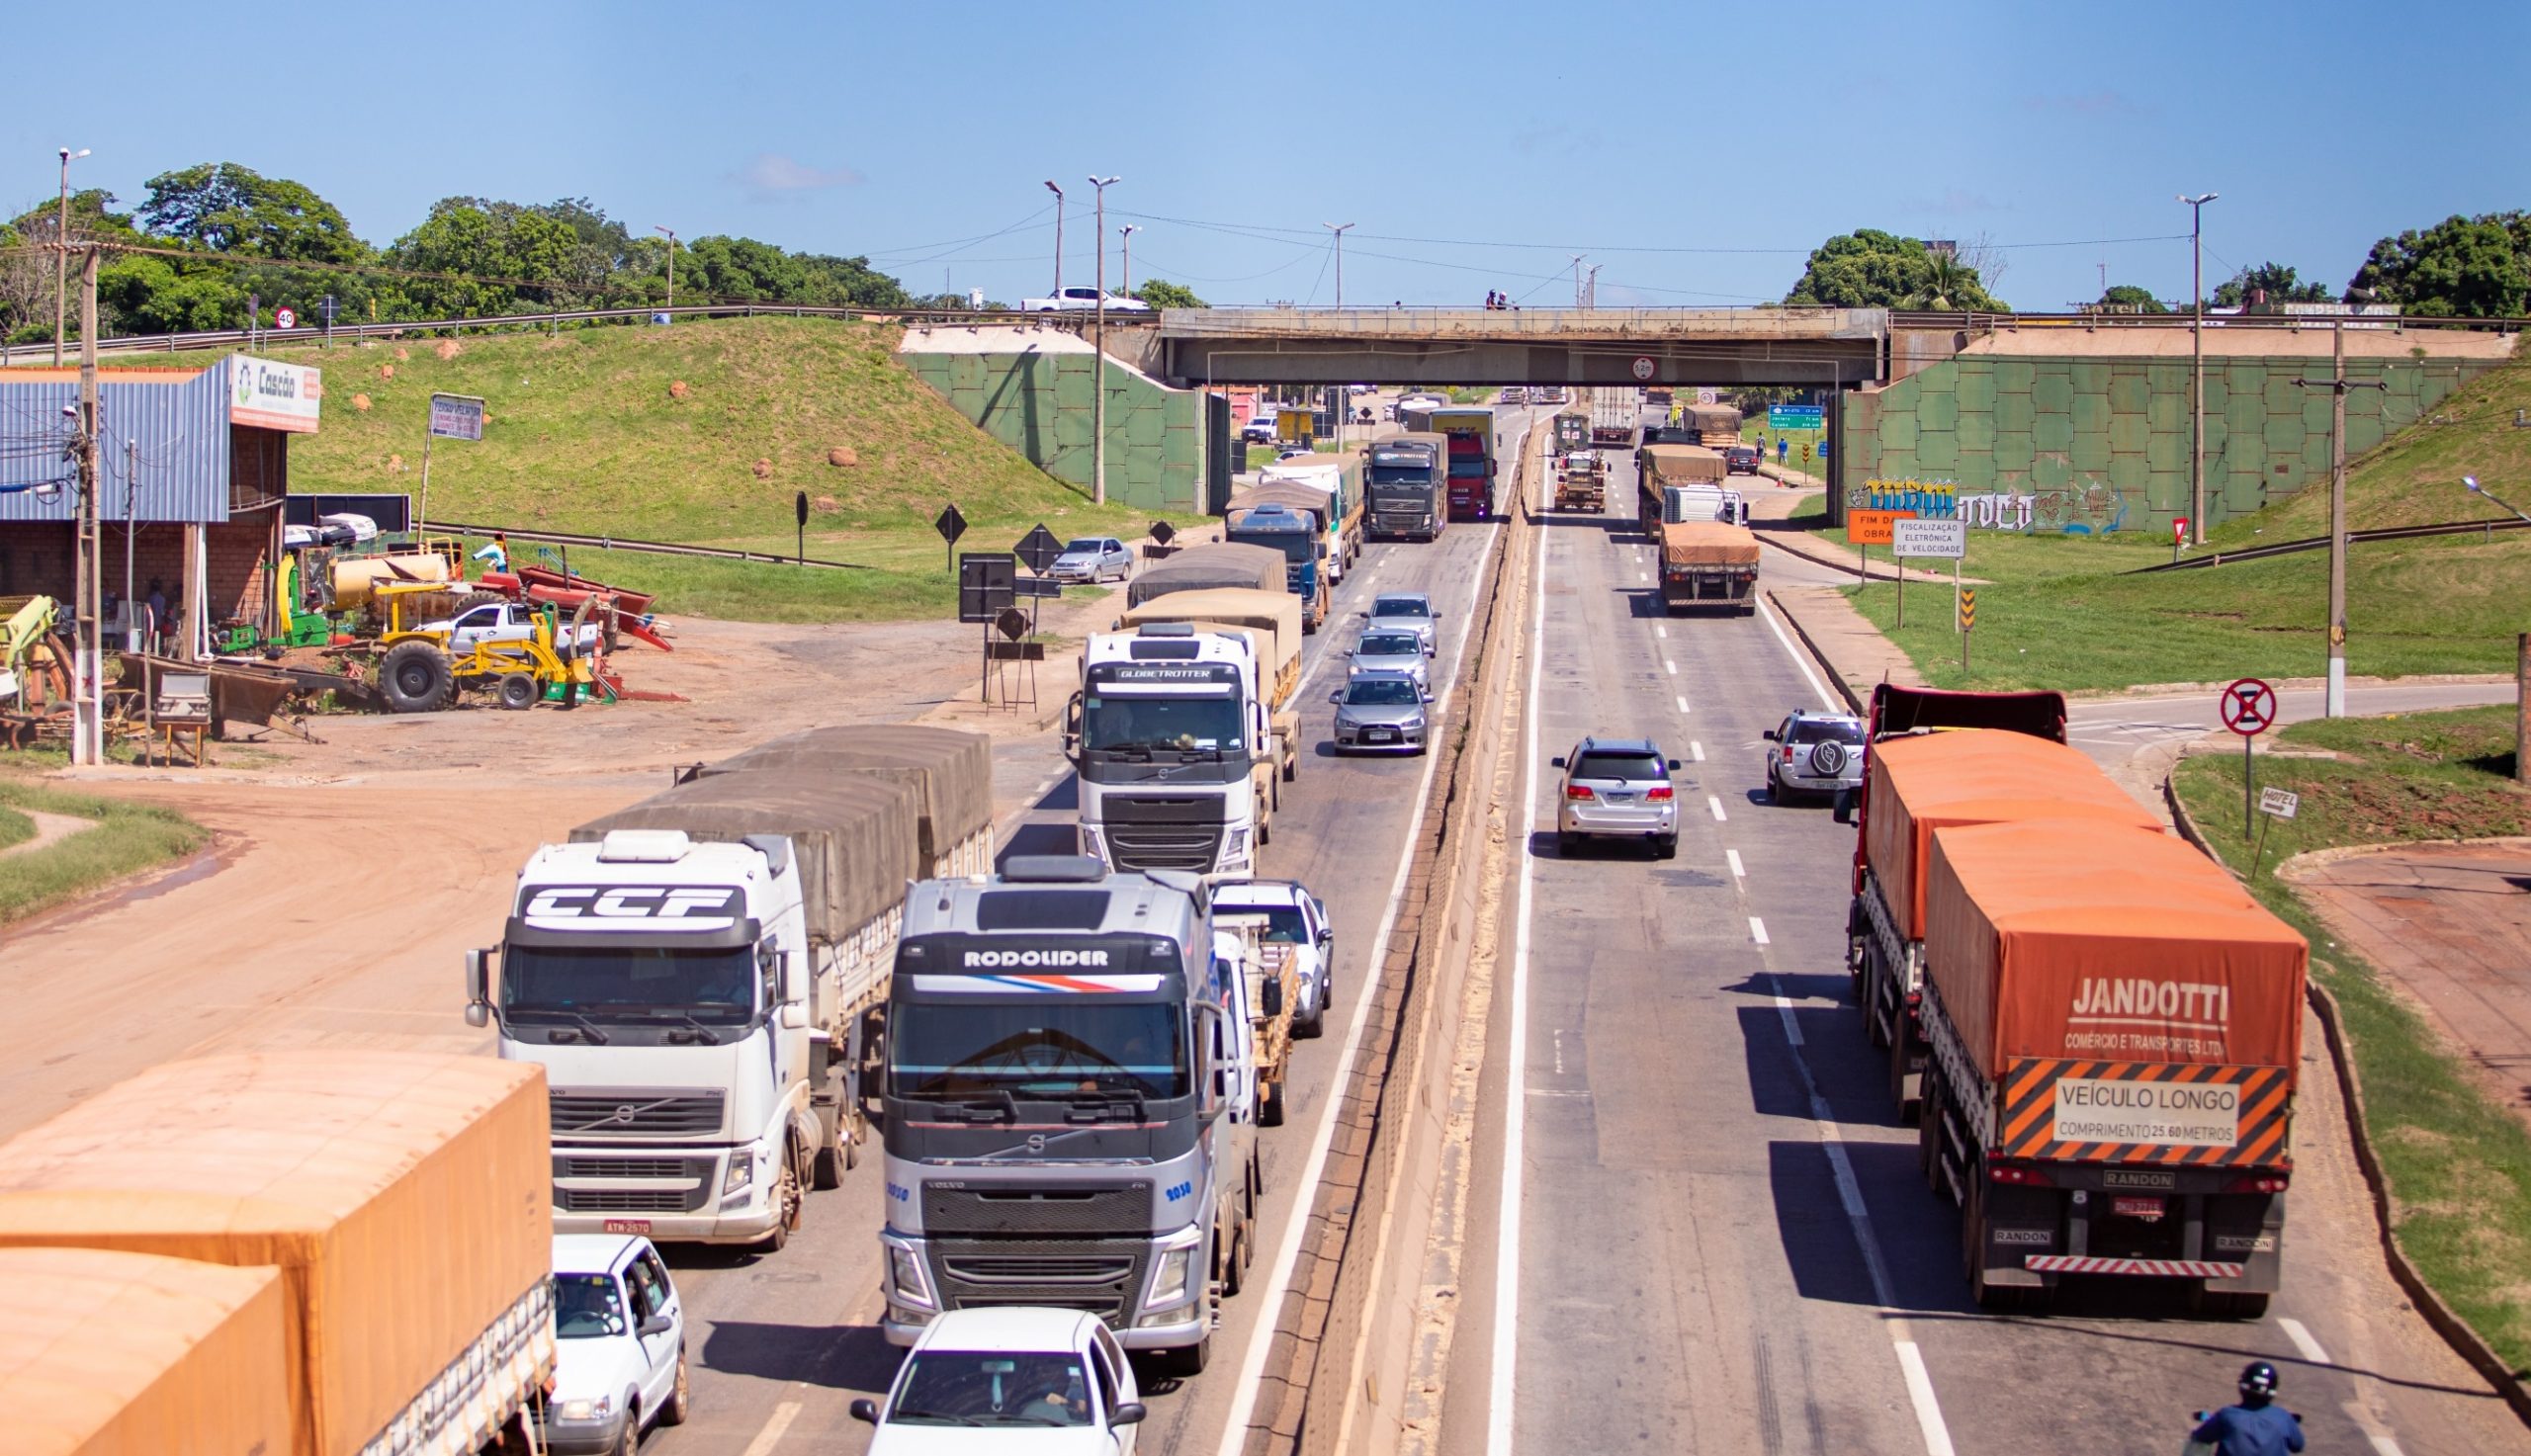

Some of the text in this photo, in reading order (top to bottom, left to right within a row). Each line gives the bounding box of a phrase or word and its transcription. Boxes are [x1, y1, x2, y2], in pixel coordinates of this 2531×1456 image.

[279, 313, 293, 323] 40
[1900, 522, 1958, 534] FISCALIZAÇÃO
[1912, 545, 1962, 554] VELOCIDADE
[2264, 790, 2294, 806] HOTEL
[964, 950, 1108, 967] RODOLIDER
[2072, 978, 2228, 1021] JANDOTTI
[2064, 1030, 2119, 1050] COMÉRCIO
[2120, 1034, 2127, 1050] E
[2129, 1034, 2201, 1055] TRANSPORTES
[2061, 1080, 2235, 1111] VEÍCULO LONGO
[2058, 1121, 2233, 1142] COMPRIMENTO 25.60 METROS
[927, 1180, 965, 1189] VOLVO
[2107, 1173, 2172, 1186] RANDON
[1997, 1232, 2048, 1242] RANDON
[2220, 1238, 2269, 1247] RANDON
